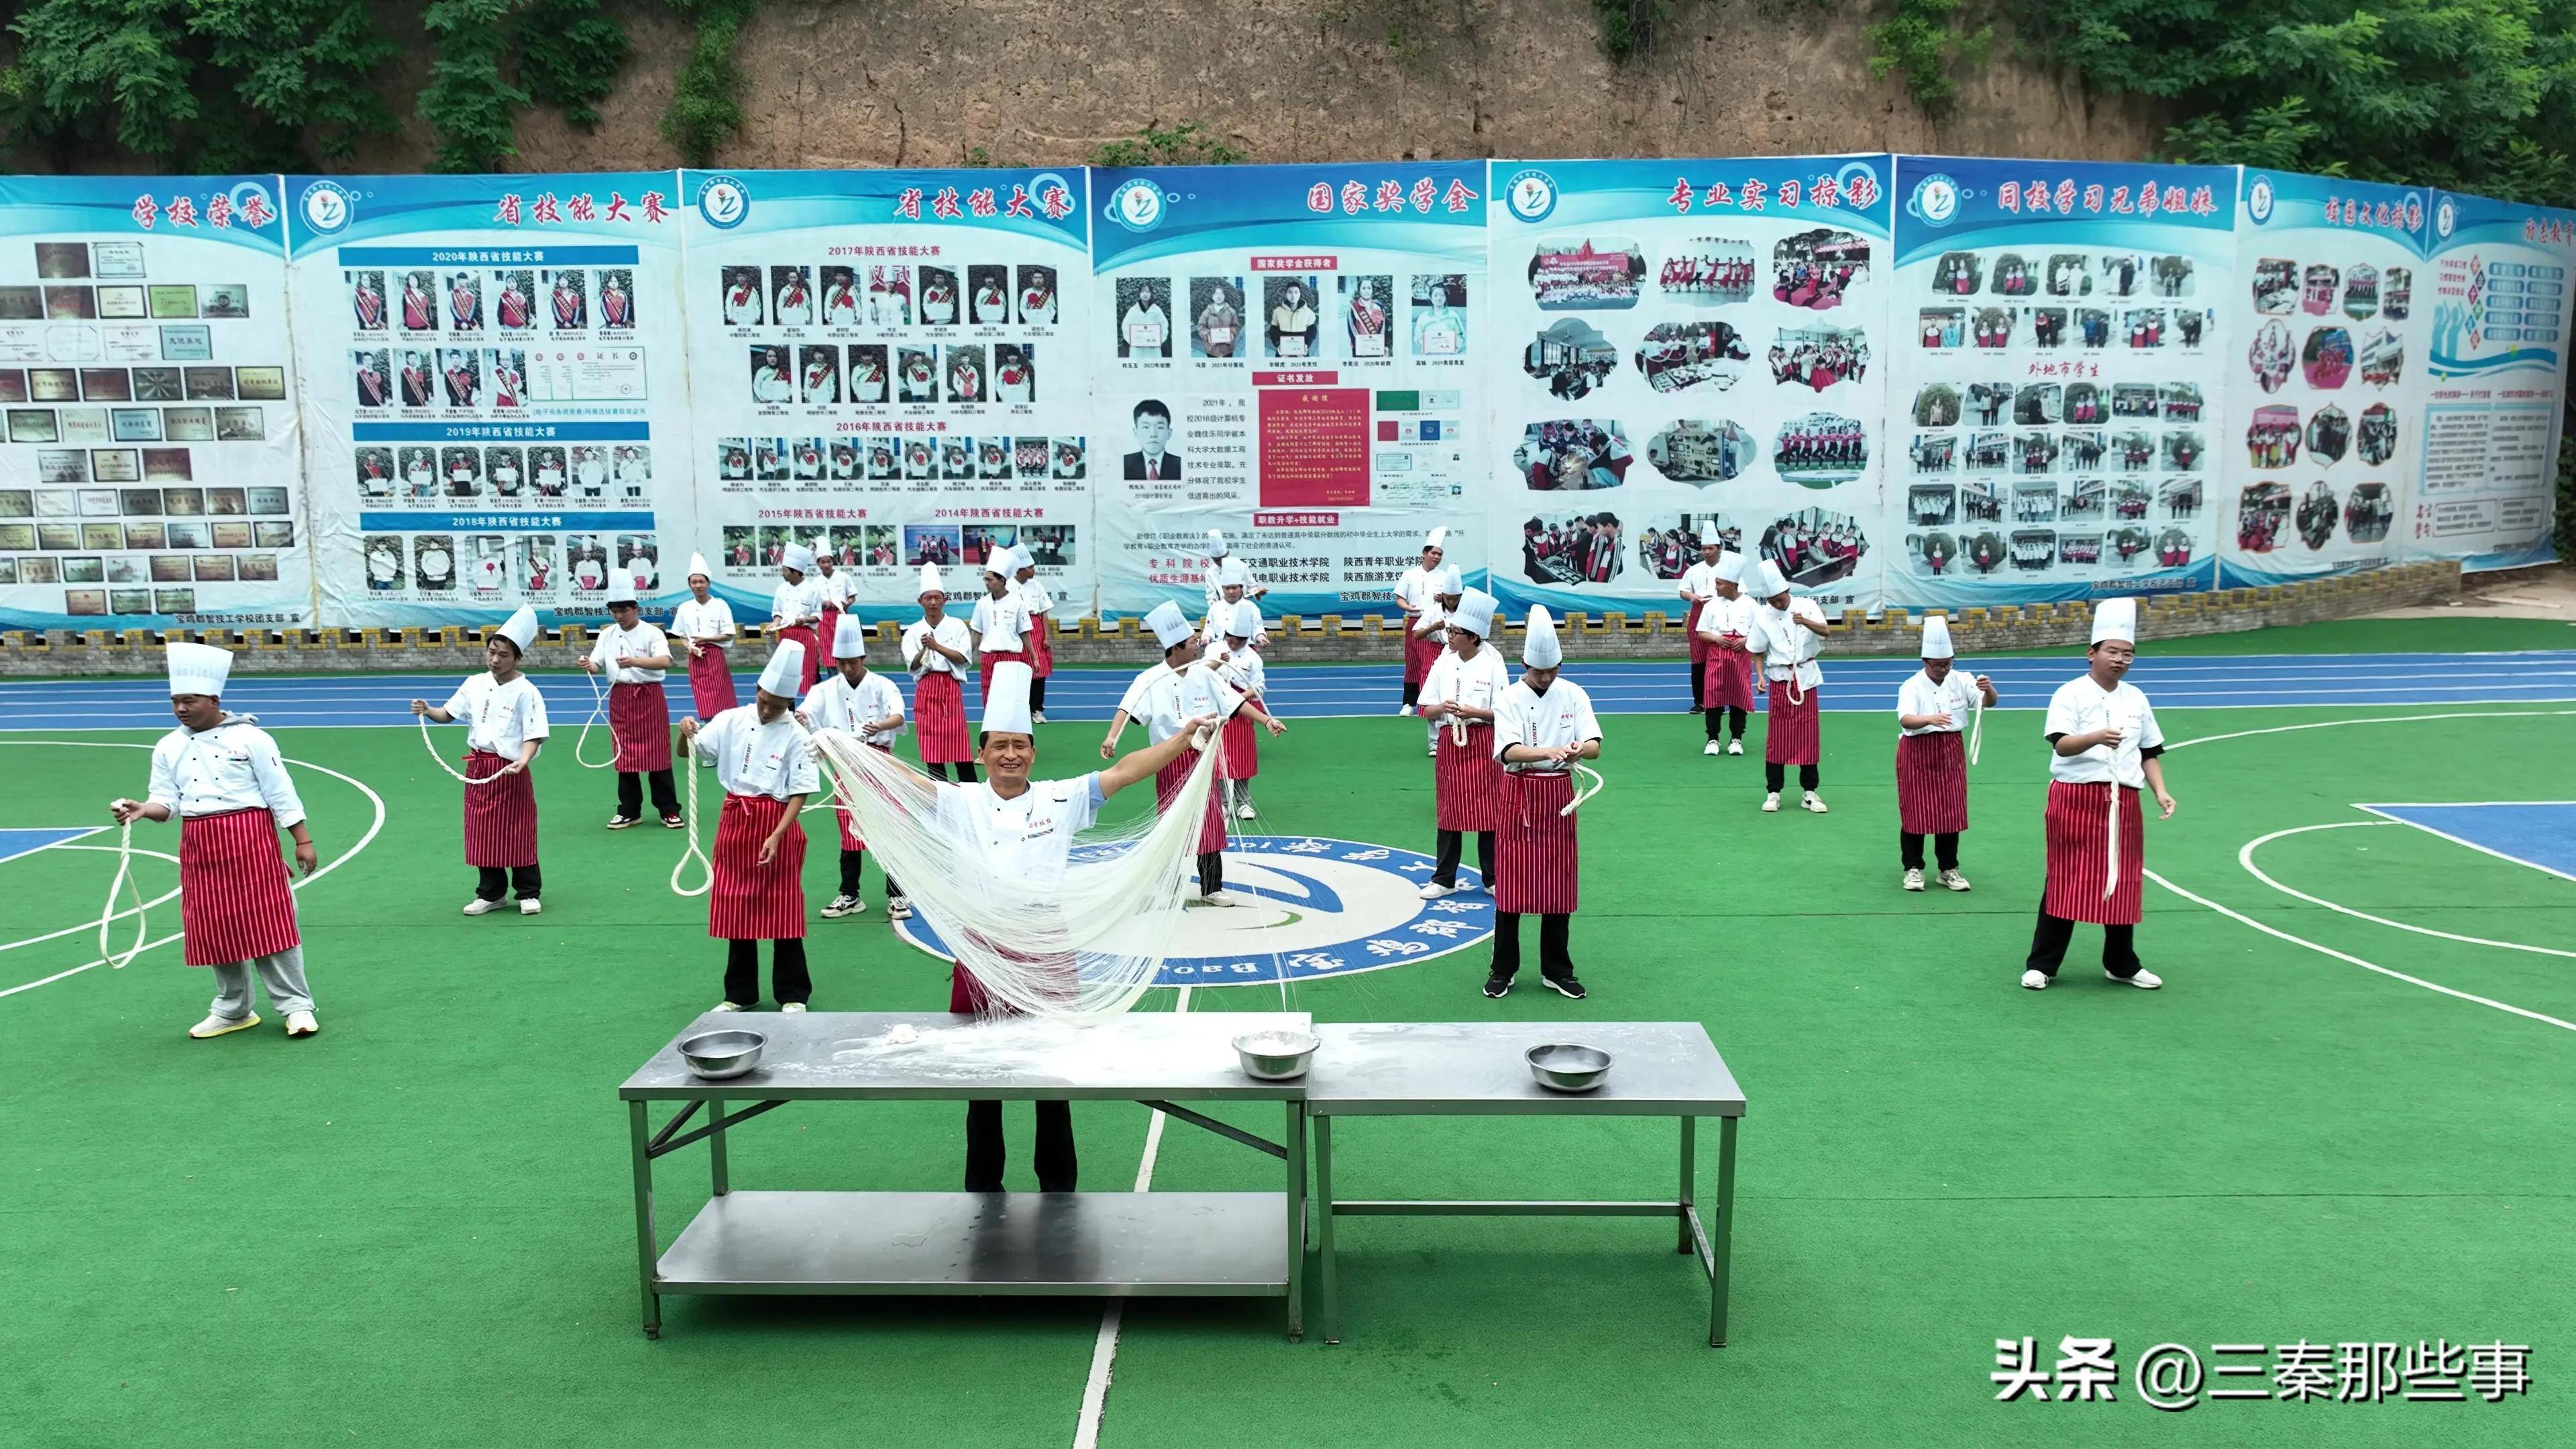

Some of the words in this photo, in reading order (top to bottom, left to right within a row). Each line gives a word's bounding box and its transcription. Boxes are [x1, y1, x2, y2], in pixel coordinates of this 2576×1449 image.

[1307, 177, 1479, 213] 国家奖学金
[1668, 177, 1877, 214] 专业实习掠影
[1998, 178, 2218, 217] 同校学习兄弟姐妹
[492, 191, 669, 225] 省技能大赛
[894, 186, 1071, 220] 省技能大赛
[132, 193, 274, 229] 学校荣誉
[2325, 197, 2424, 233] 校园文化掠影
[432, 251, 544, 262] 2020年陕西省技能大赛
[828, 246, 941, 257] 2017年陕西省技能大赛
[1256, 258, 1332, 269] 国家奖学金获得者
[2027, 361, 2100, 378] 外地市学生
[1277, 374, 1314, 383] 证书发放
[1301, 394, 1329, 402] 感谢信
[1187, 415, 1246, 423] 校2018级计算机专
[836, 421, 947, 432] 2016年陕西省技能大赛
[446, 427, 556, 438] 2019年陕西省技能大赛
[1187, 430, 1246, 438] 业魏佳乐同学被本
[1187, 445, 1246, 453] 科大学大数据工程
[1187, 476, 1246, 484] 分体现了我校学生
[758, 508, 868, 519] 2015年陕西省技能大赛
[934, 508, 1044, 519] 2014年陕西省技能大赛
[452, 516, 562, 527] 2018年陕西省技能大赛
[1258, 515, 1336, 525] 职教升学+技能就业
[1148, 558, 1210, 569] 专科院校
[1240, 557, 1330, 568] 西交通职业技术学院
[1344, 557, 1424, 567] 陕西青年职业学院
[1057, 591, 1068, 600] 宣
[175, 613, 284, 624] 宝鸡郡智技工学校团支部
[1163, 961, 1260, 975] Bao
